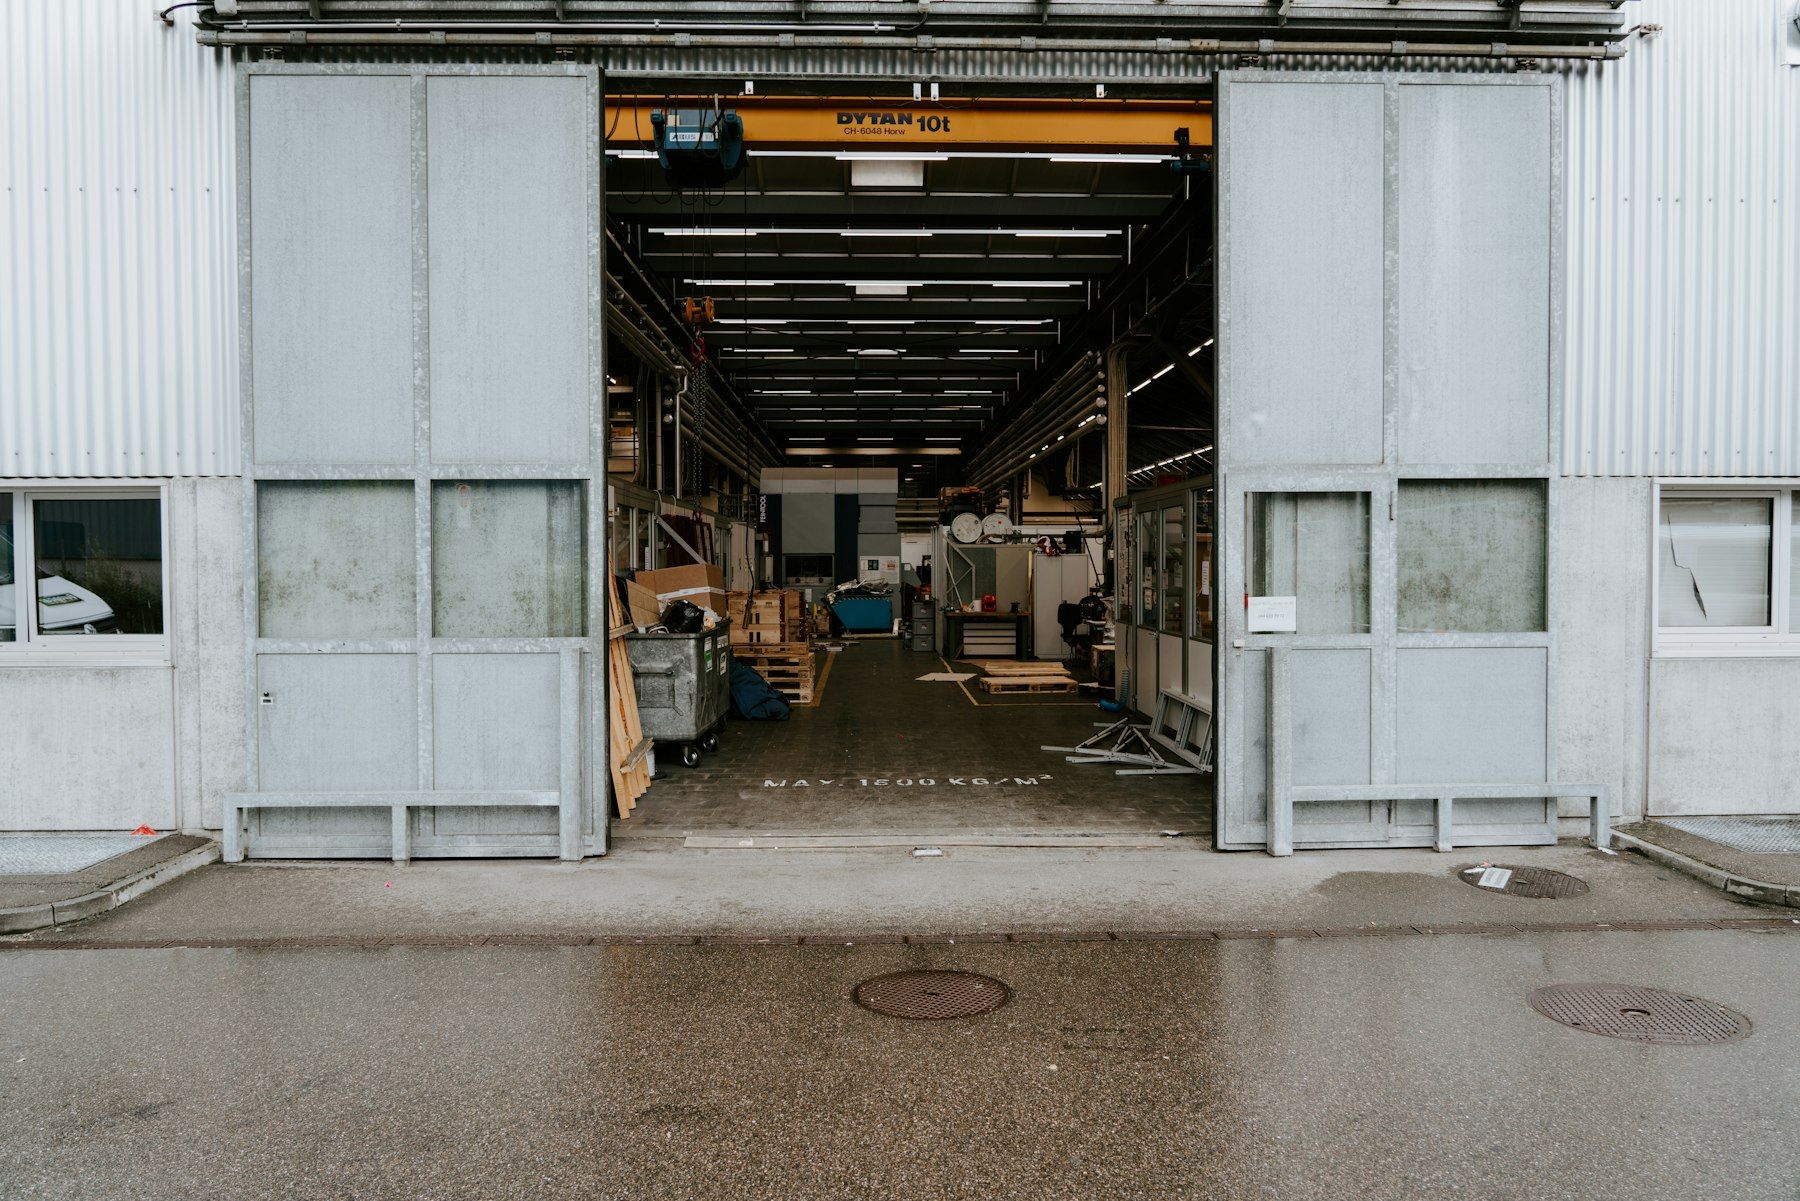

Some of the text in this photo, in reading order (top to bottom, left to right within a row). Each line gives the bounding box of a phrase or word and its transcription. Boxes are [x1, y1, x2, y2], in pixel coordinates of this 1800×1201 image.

[837, 112, 913, 125] DYTAN
[917, 115, 951, 133] 10t
[844, 127, 906, 135] CH-6048 Horw
[860, 778, 936, 787] 1500
